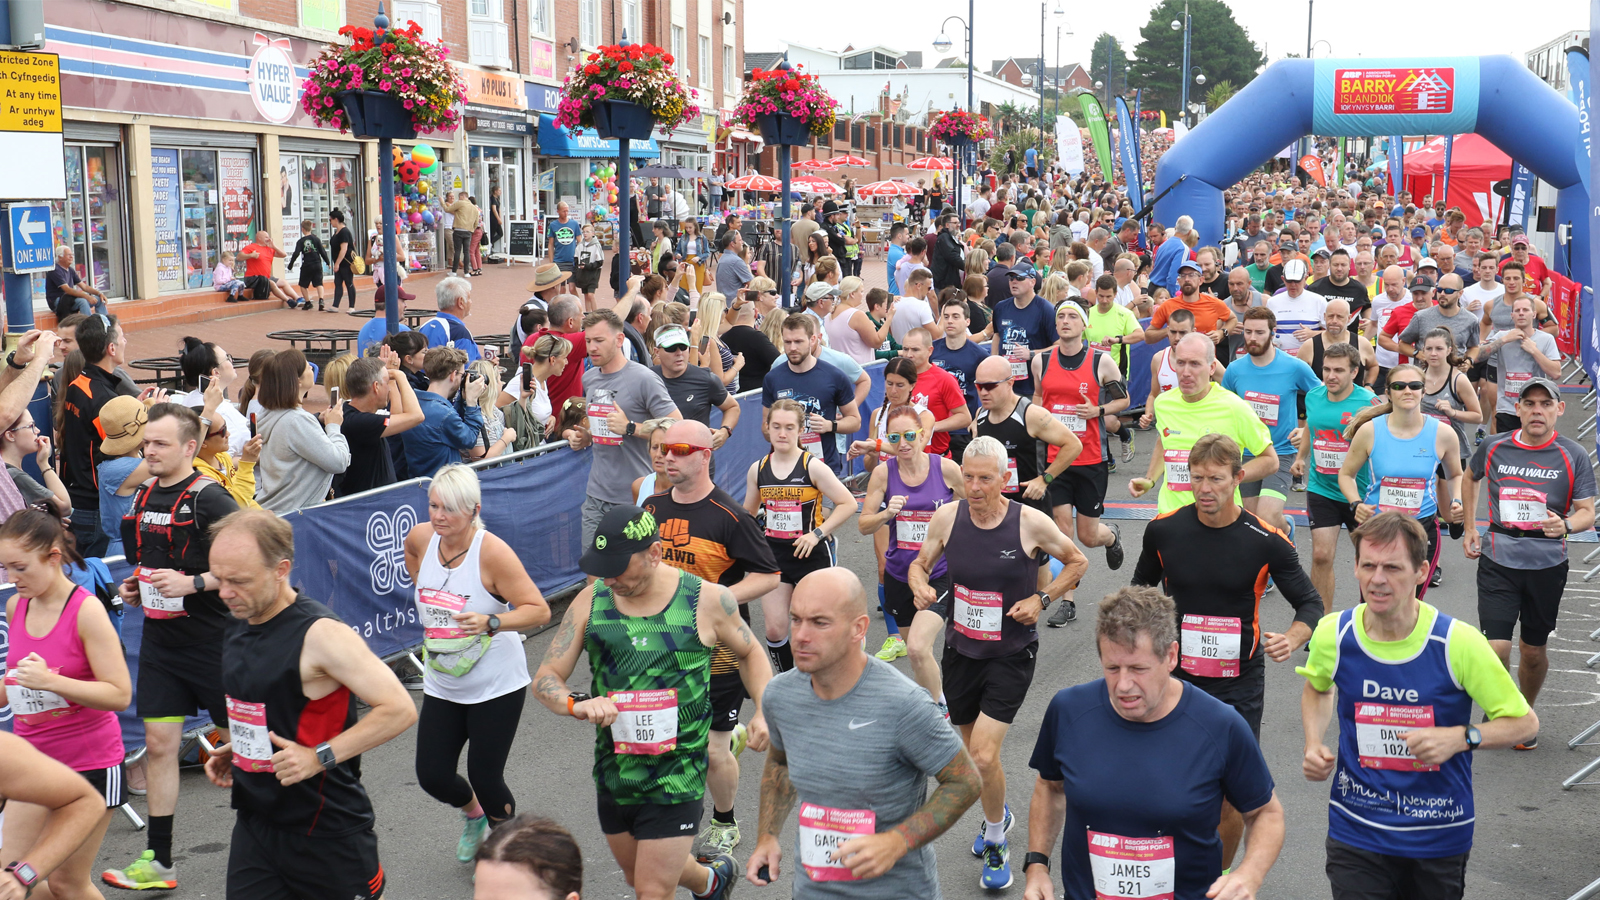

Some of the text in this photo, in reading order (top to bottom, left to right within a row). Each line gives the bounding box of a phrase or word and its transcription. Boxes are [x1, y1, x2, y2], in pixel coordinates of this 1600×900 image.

[32, 57, 54, 66] Zone
[10, 71, 56, 84] Cyfngedig
[258, 62, 290, 83] HYPER
[491, 79, 506, 97] PLUS
[508, 82, 511, 98] 1
[1341, 80, 1397, 94] BARRY
[6, 89, 57, 100] At any time
[259, 83, 292, 104] VALUE
[10, 105, 56, 116] Ar unrhyw
[23, 118, 44, 128] adeg
[476, 119, 490, 128] BURGERS
[17, 248, 51, 264] ONE WAY
[1254, 403, 1268, 411] LEWIS
[1177, 474, 1189, 482] 783
[784, 488, 804, 497] VALLEY
[1388, 489, 1418, 498] CAROLINE
[1395, 498, 1407, 506] 204
[1518, 503, 1530, 511] IAN
[1517, 512, 1530, 520] 227
[148, 525, 170, 534] SPRIN
[776, 522, 787, 530] 582
[912, 532, 925, 542] 497
[151, 600, 165, 609] 675
[967, 606, 984, 618] DAVE
[967, 618, 981, 629] 230
[1202, 634, 1219, 646] NEIL
[1202, 646, 1218, 658] 802
[1362, 679, 1418, 702] Dave
[1359, 705, 1384, 716] ABP
[636, 714, 653, 726] LEE
[636, 728, 654, 740] 809
[1402, 794, 1454, 806] Newport
[802, 806, 825, 820] ABP
[1404, 805, 1464, 822] Casnewydd
[1091, 834, 1120, 848] ABP
[1110, 863, 1151, 878] JAMES
[1118, 881, 1142, 896] 521
